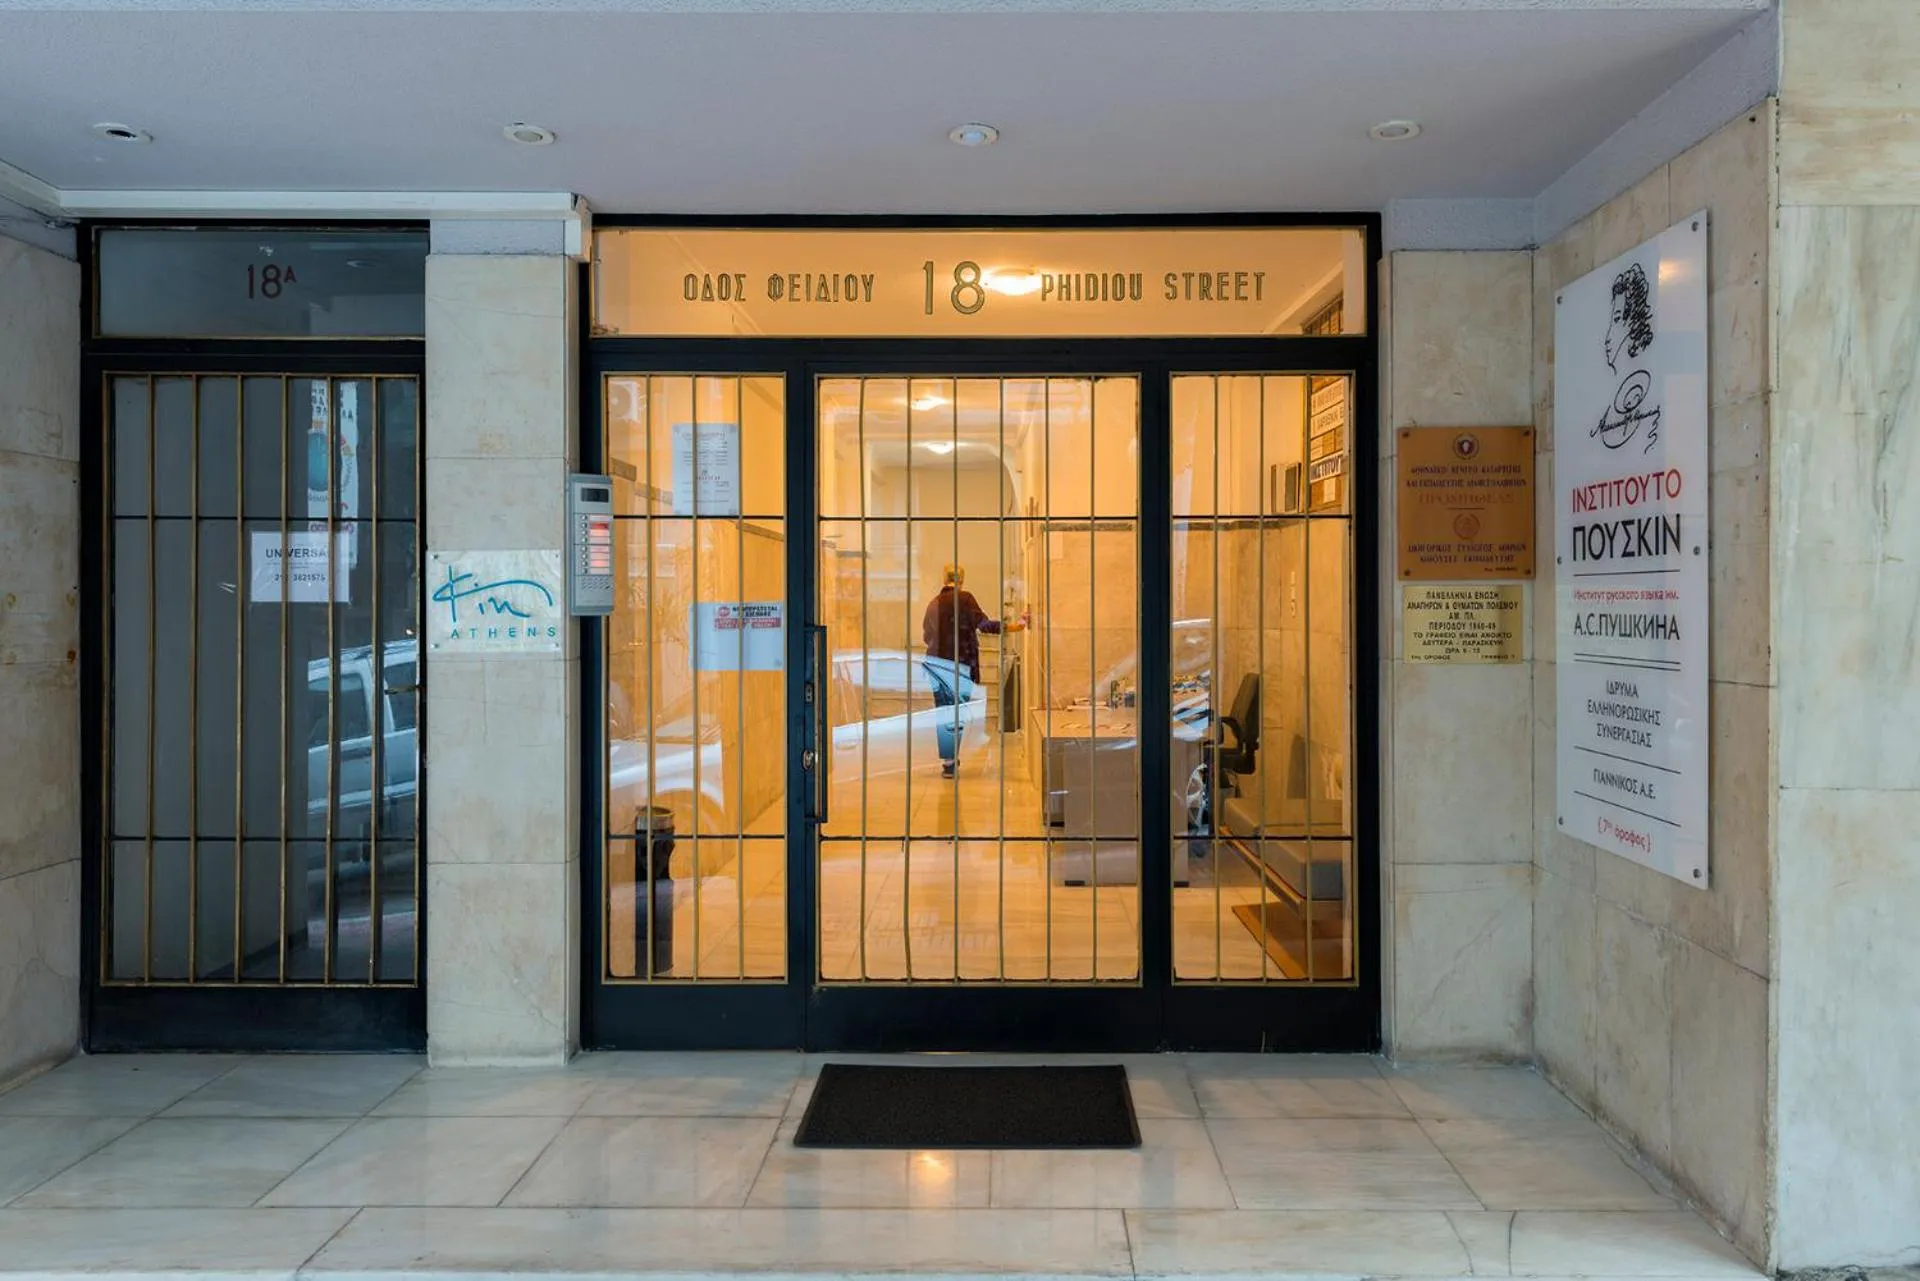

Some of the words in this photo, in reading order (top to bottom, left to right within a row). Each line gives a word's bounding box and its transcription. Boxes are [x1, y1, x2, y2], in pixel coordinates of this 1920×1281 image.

[683, 273, 747, 302] ΟΔΟΣ
[767, 273, 875, 303] ΦΕΙΔΙΟΥ
[922, 260, 986, 315] 18
[1041, 273, 1144, 302] PHIDIOU
[1164, 271, 1267, 302] STREET
[1572, 468, 1682, 513] ΙΝΣΤΙΤΟΥΤΟ
[1572, 513, 1682, 562] ΠΟΥΣΚΙΝ
[1407, 601, 1443, 610] ΑΝΑΠΗΡΩΝ
[1445, 602, 1450, 610] &
[1452, 601, 1484, 609] ΘΥΜΑΤΩΝ
[1426, 591, 1472, 599] ΠΑΝΕΛΛΗΝΙΑ
[1475, 591, 1499, 599] ΕΝΩΣΗ
[1606, 590, 1638, 604] русского
[451, 626, 556, 640] ATHENS
[1428, 622, 1466, 630] ΠΕΡΙΟΔΟΥ
[1574, 612, 1680, 640] А.С.ПУШКИНА
[1606, 679, 1639, 698] ΙΔΡΥΜΑ
[1587, 698, 1661, 726] ΕΛΛΗΝΟΡΩΣΙΚΗΣ
[1596, 722, 1653, 748] ΣΥΝΕΡΓΑΣΙΑΣ
